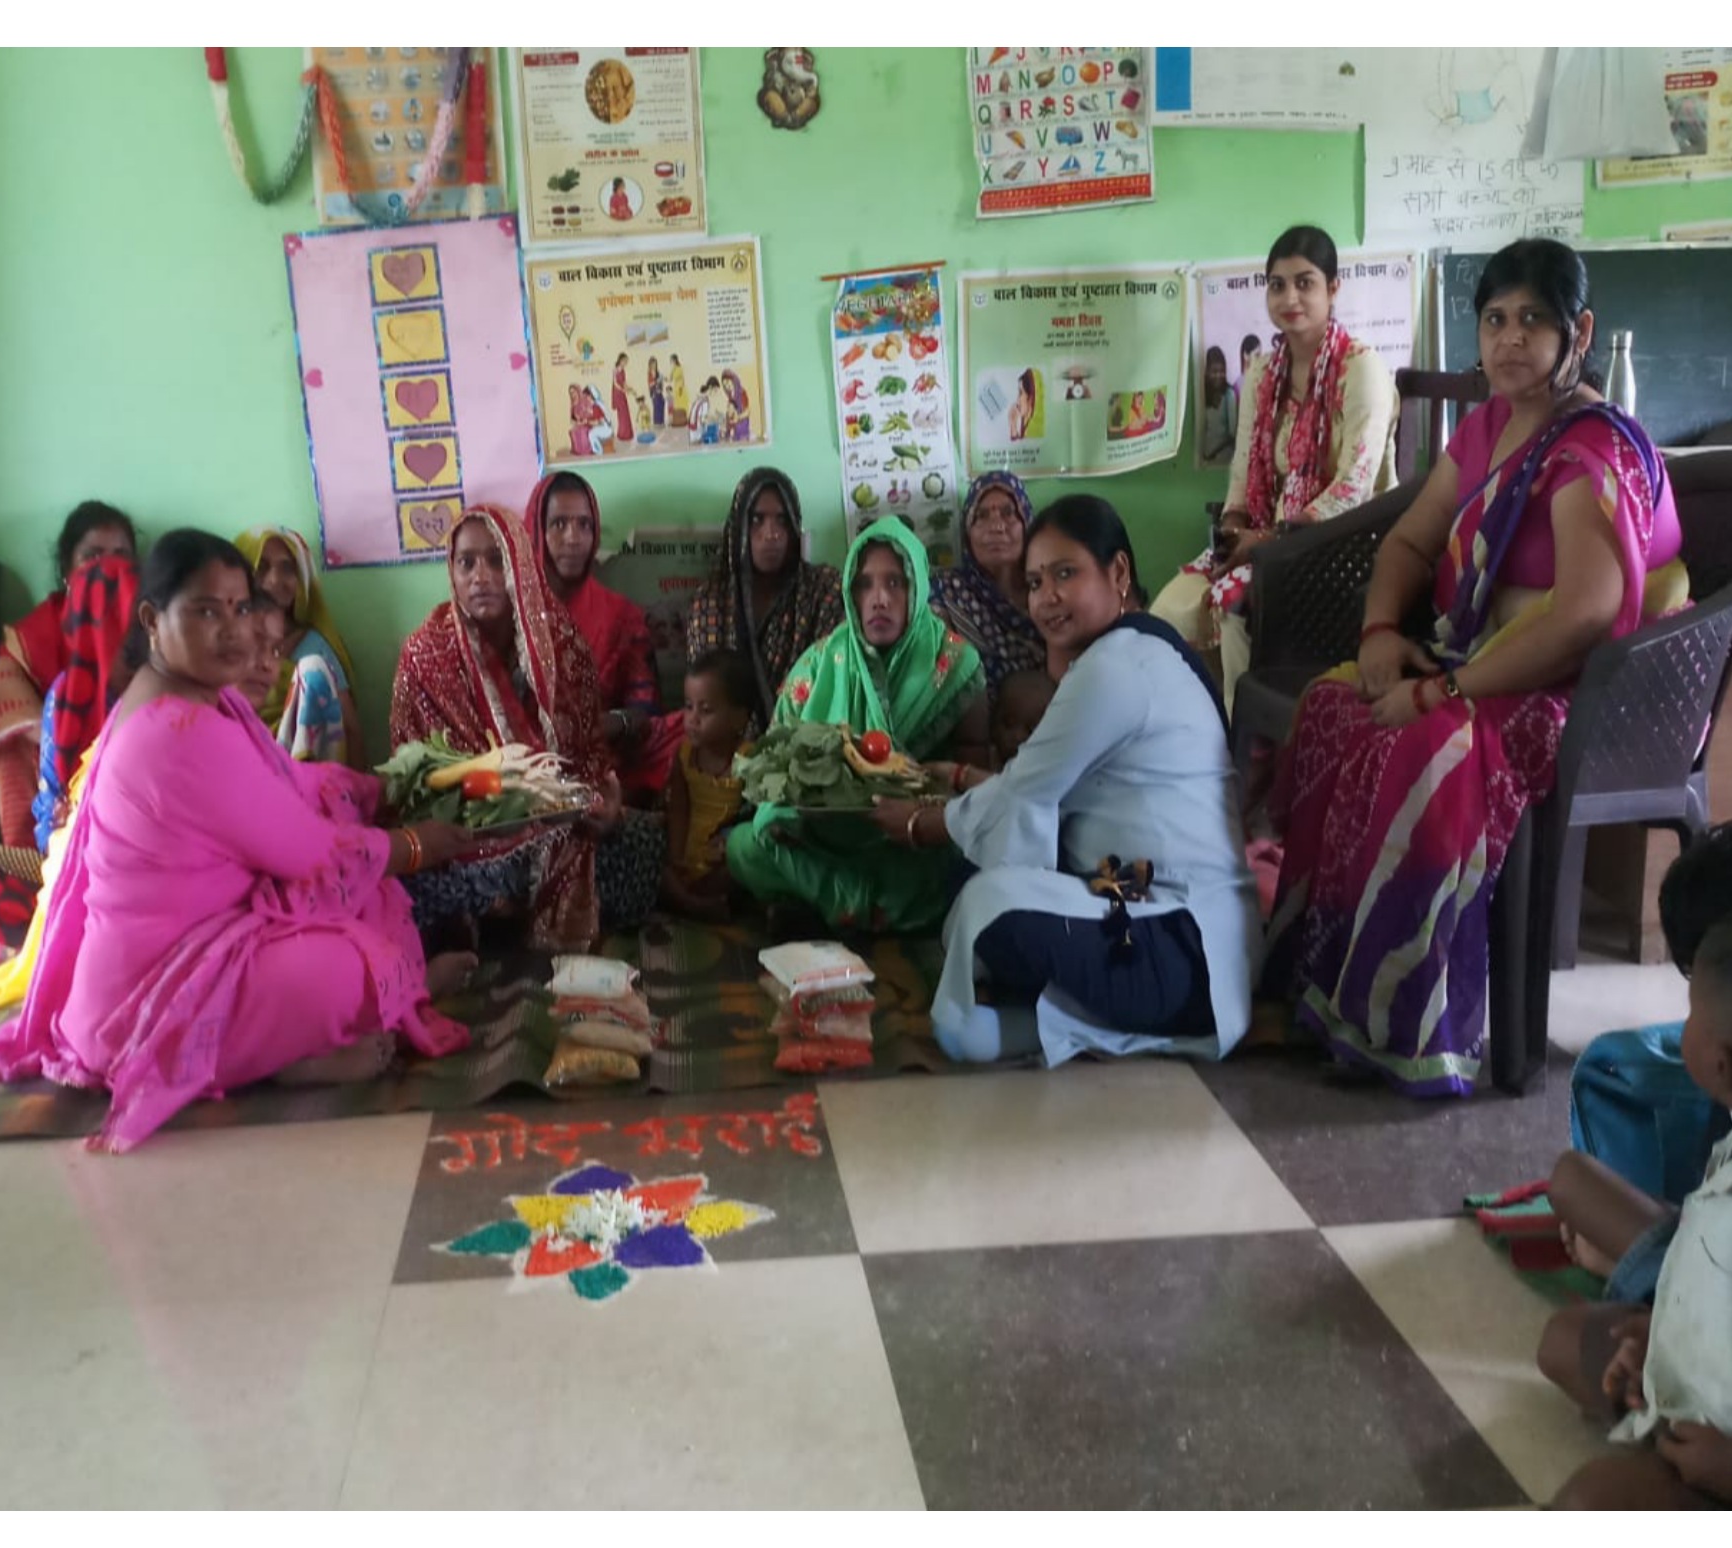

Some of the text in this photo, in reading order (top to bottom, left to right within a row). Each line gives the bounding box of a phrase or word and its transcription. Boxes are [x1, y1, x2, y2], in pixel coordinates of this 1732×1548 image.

[977, 61, 1114, 95] M N O P
[978, 91, 1115, 125] Q R S T
[981, 121, 1110, 155] U V W
[983, 151, 1106, 184] X Y Z
[557, 255, 726, 283] बाल विकास एवं पुष्टाहार विभाग
[1227, 276, 1250, 290] बाल
[994, 280, 1157, 301] बाल विकास एवं पुष्टाहार विभाग
[428, 1113, 613, 1173] गोद
